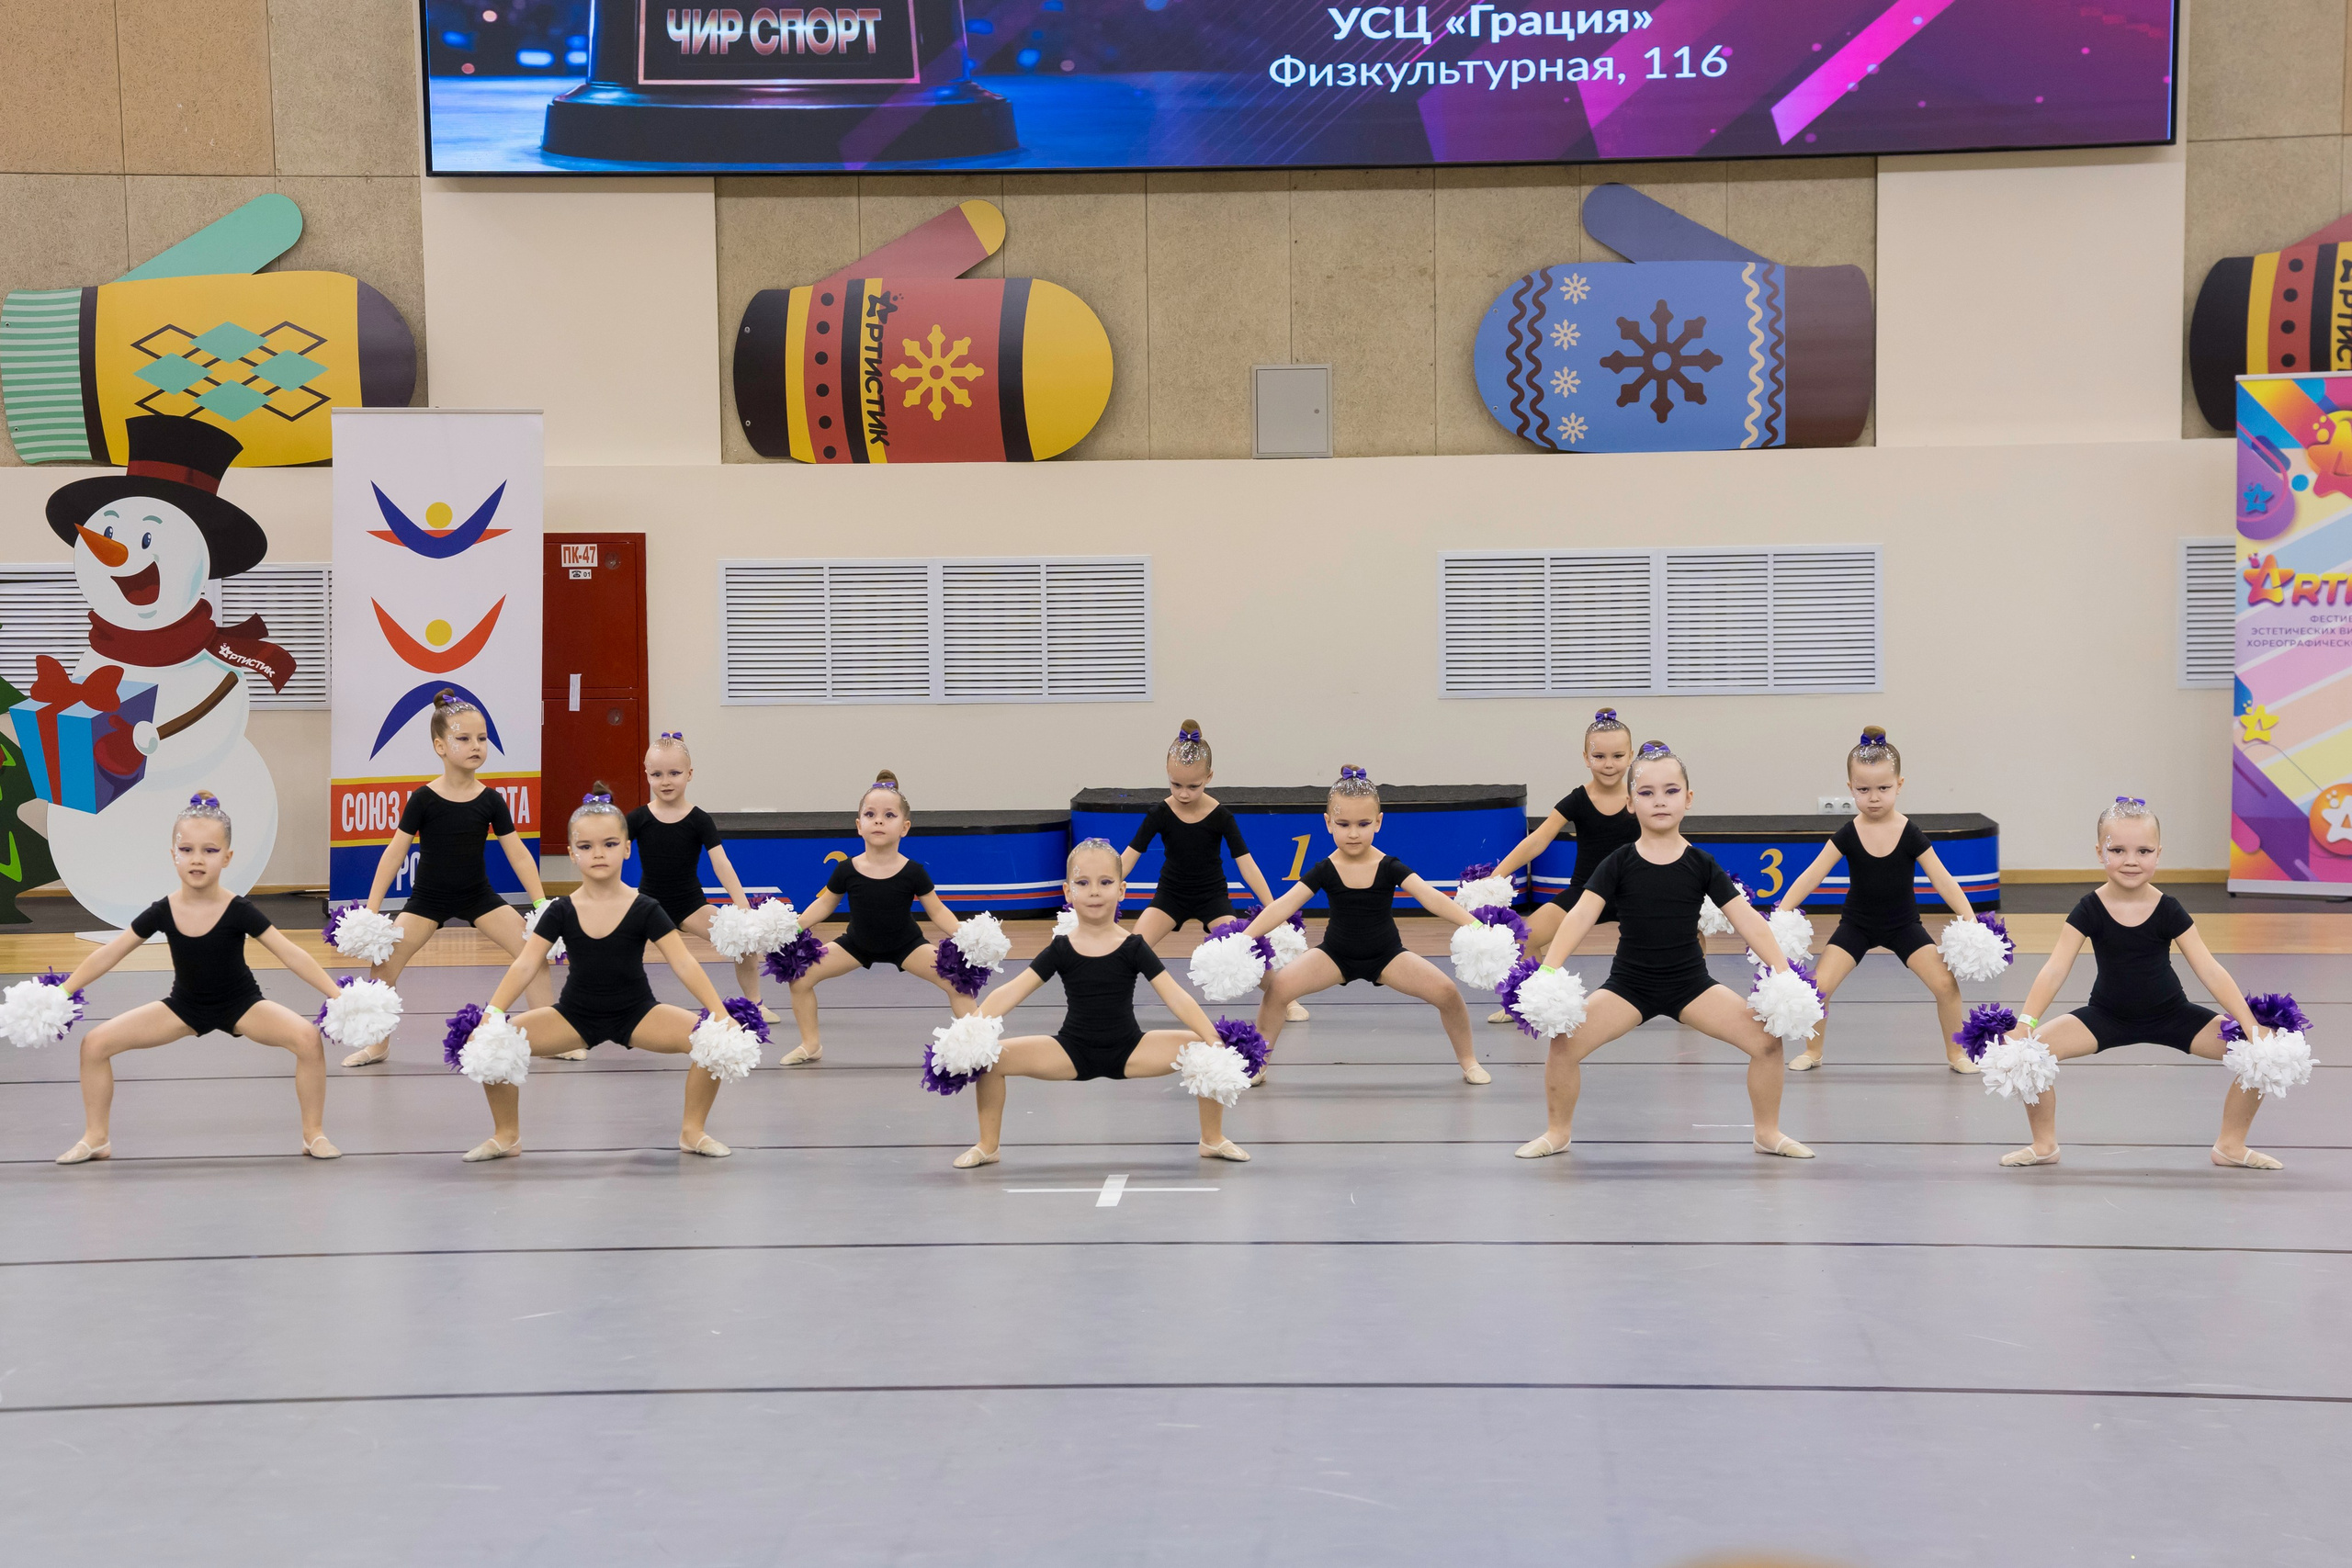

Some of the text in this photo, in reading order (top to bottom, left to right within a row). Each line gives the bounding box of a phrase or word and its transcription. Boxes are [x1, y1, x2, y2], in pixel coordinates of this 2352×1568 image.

[667, 7, 881, 55] ЧИР СПОРТ
[1328, 5, 1654, 45] УСЦ «Грация»
[1269, 45, 1728, 93] Физкультурная, 116
[865, 290, 899, 446] АРТИСТИК
[562, 546, 596, 564] ПК-47
[2251, 627, 2336, 636] ЭСТЕТИЧЕСКИХ
[219, 644, 276, 678] АРТИСТИК
[342, 791, 400, 832] СОЮЗ
[1281, 834, 1312, 881] 1
[1757, 848, 1783, 898] 3
